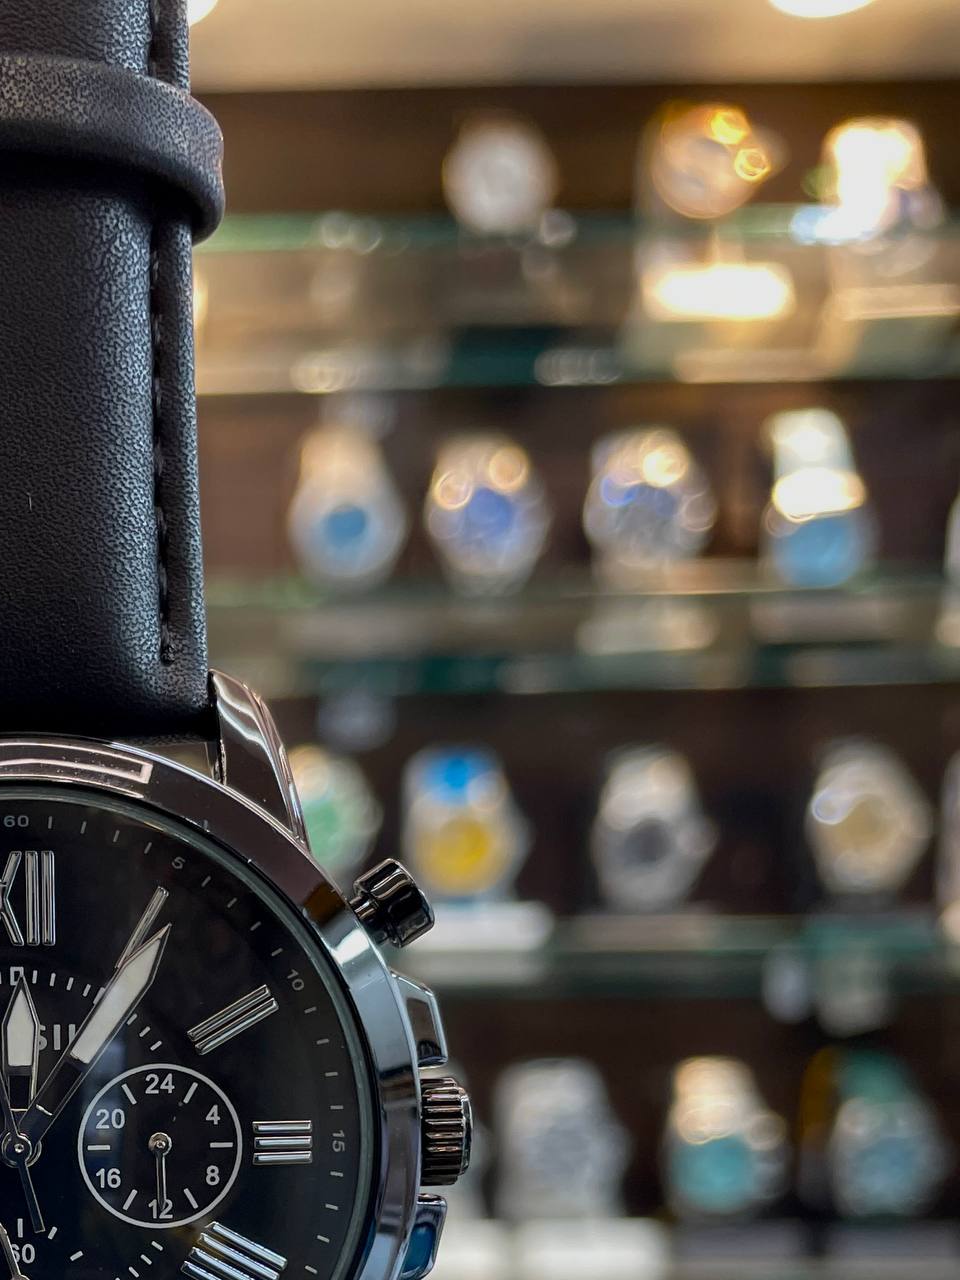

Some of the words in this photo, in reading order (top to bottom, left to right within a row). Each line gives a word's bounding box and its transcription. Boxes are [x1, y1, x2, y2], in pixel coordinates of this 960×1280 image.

[4, 815, 29, 828] 60
[171, 856, 186, 870] 5
[287, 968, 305, 991] 10
[187, 984, 279, 1056] II
[144, 1073, 175, 1094] 24
[95, 1108, 126, 1130] 20
[205, 1104, 221, 1125] 4
[252, 1120, 313, 1166] III
[333, 1130, 345, 1153] 15
[96, 1168, 122, 1189] 16
[205, 1165, 220, 1185] 8
[148, 1198, 173, 1219] 12
